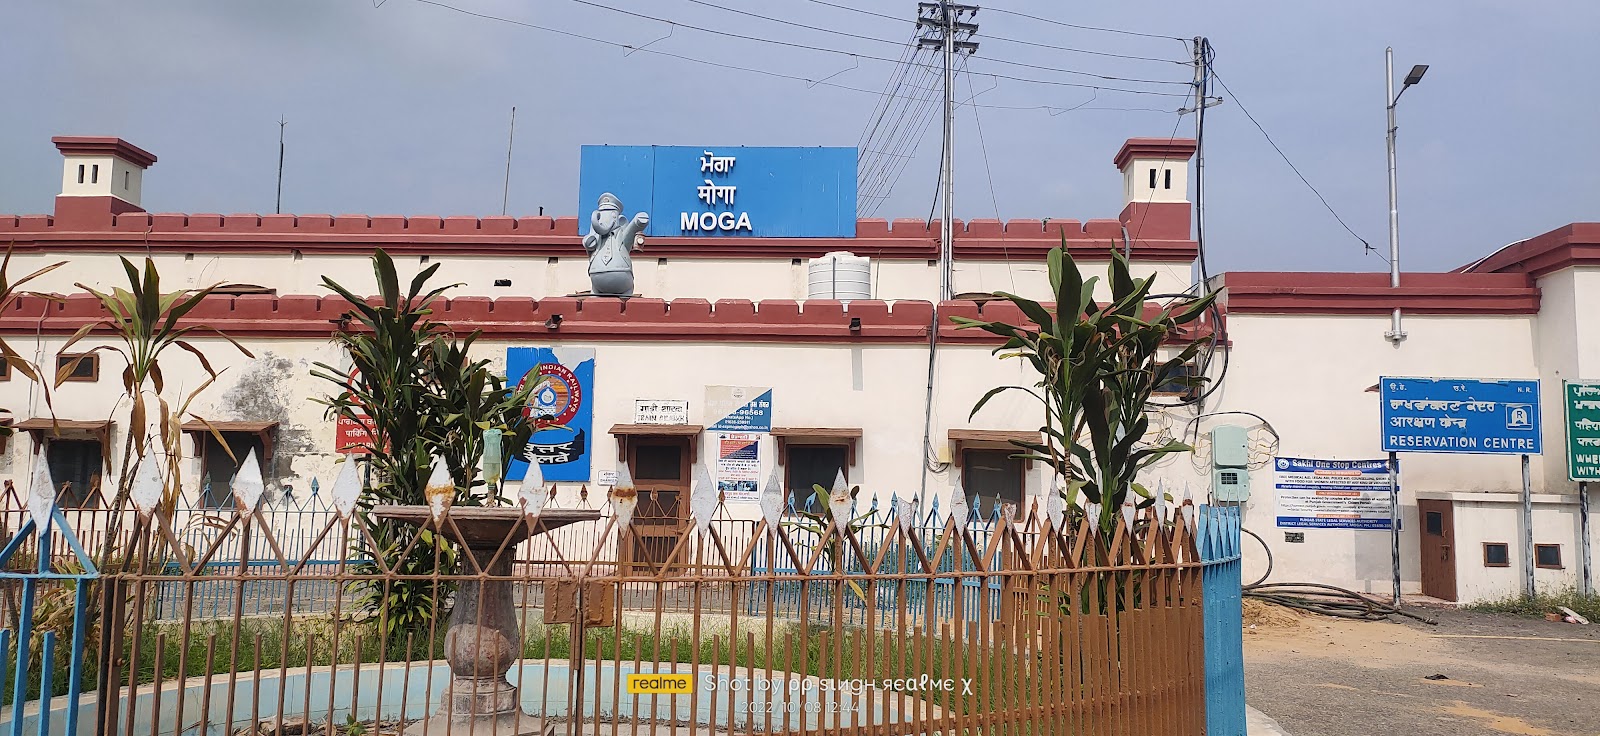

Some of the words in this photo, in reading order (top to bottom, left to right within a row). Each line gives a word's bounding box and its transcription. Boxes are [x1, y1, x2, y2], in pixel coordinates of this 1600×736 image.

[700, 149, 736, 173] ਮੋਗਾ
[697, 179, 737, 206] मोगा
[680, 211, 753, 231] MOGA
[541, 364, 567, 375] INDIAN
[567, 373, 580, 412] RAILWAYS
[1390, 416, 1436, 429] आरक्षण
[1389, 435, 1477, 448] RESERVATION
[1483, 437, 1535, 449] CENTRE
[1292, 459, 1313, 468] Sakhi
[1332, 461, 1350, 470] Stop
[1351, 461, 1381, 469] Centres
[1576, 454, 1600, 464] WHE
